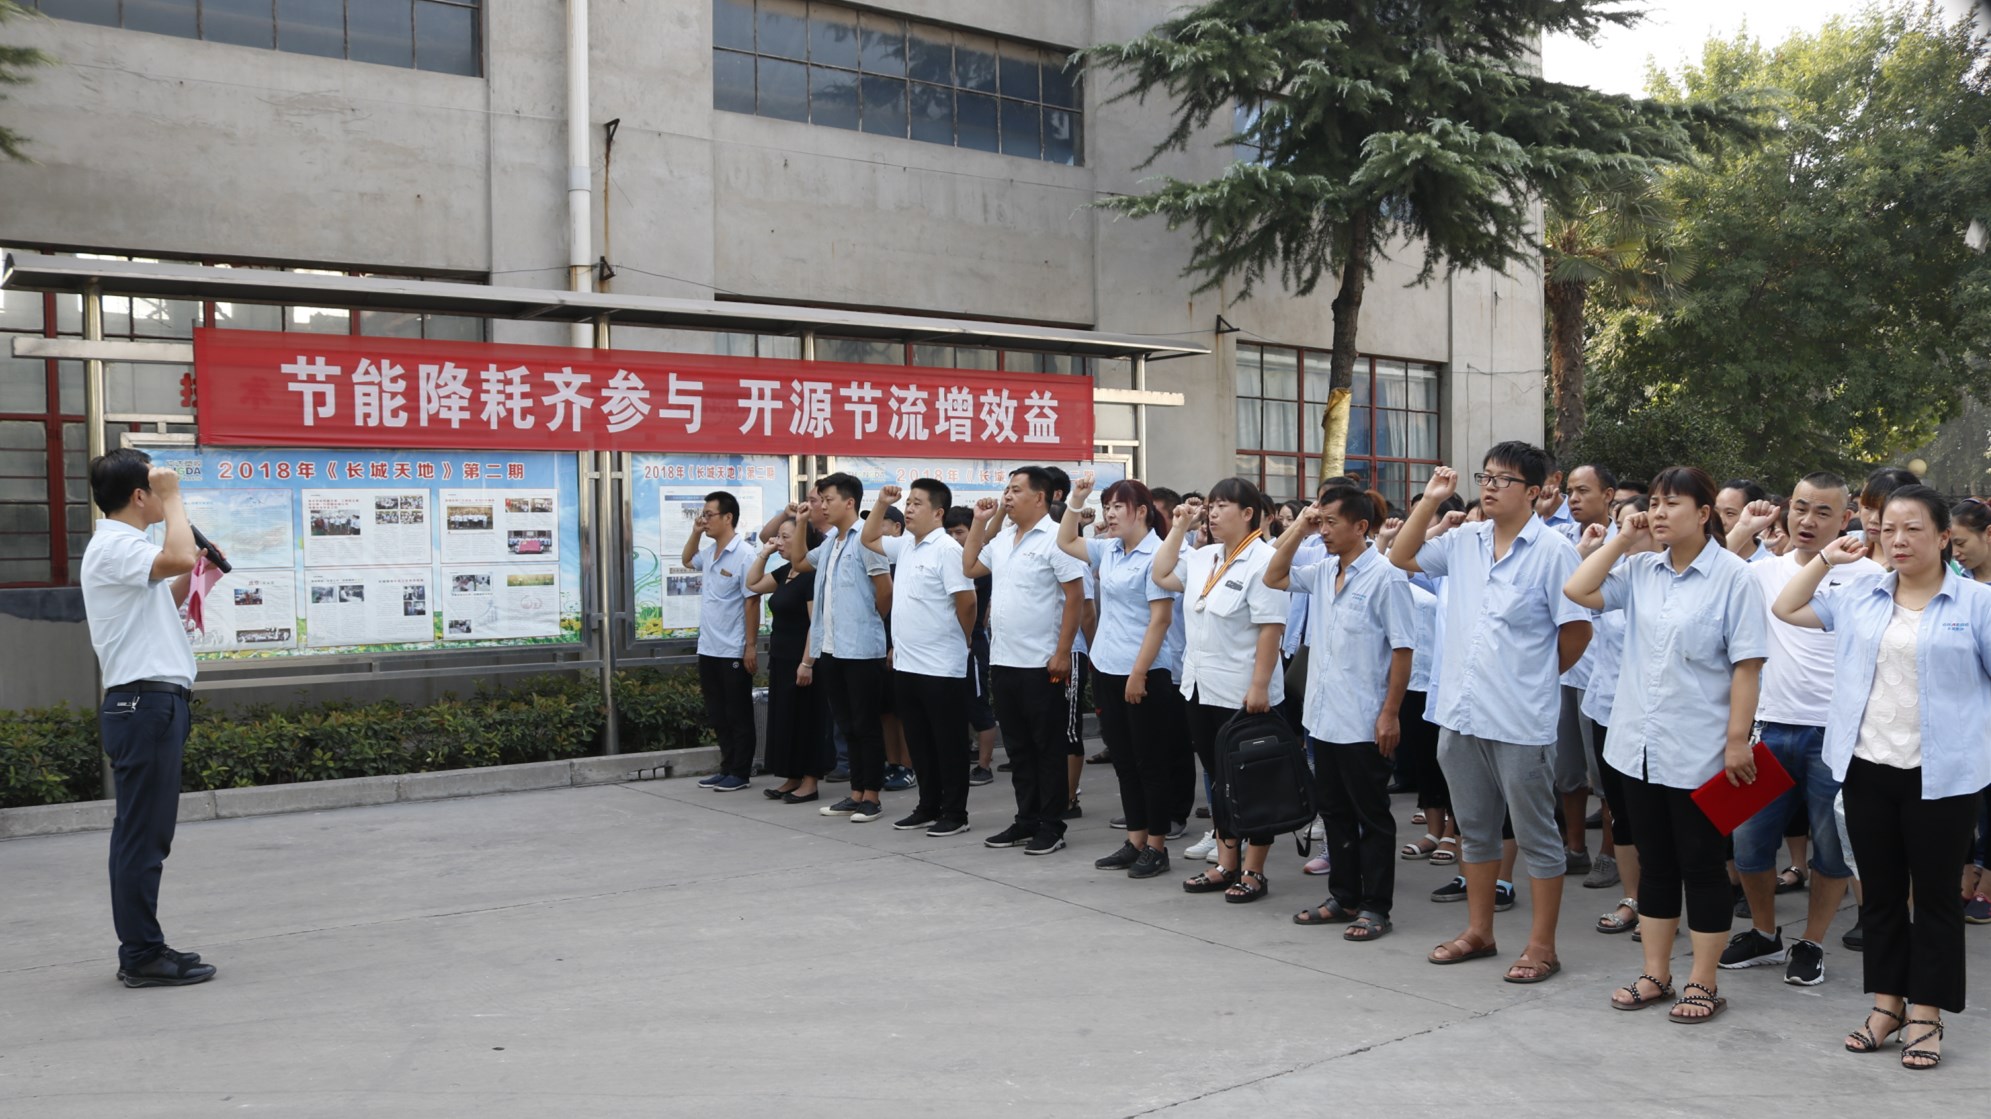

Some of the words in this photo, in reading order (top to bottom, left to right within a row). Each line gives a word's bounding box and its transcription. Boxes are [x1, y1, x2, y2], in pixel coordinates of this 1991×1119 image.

[280, 355, 704, 434] 节能降耗齐参与
[737, 378, 1061, 444] 开源节流增效益
[218, 461, 525, 479] 2018年《长城天地》第二期
